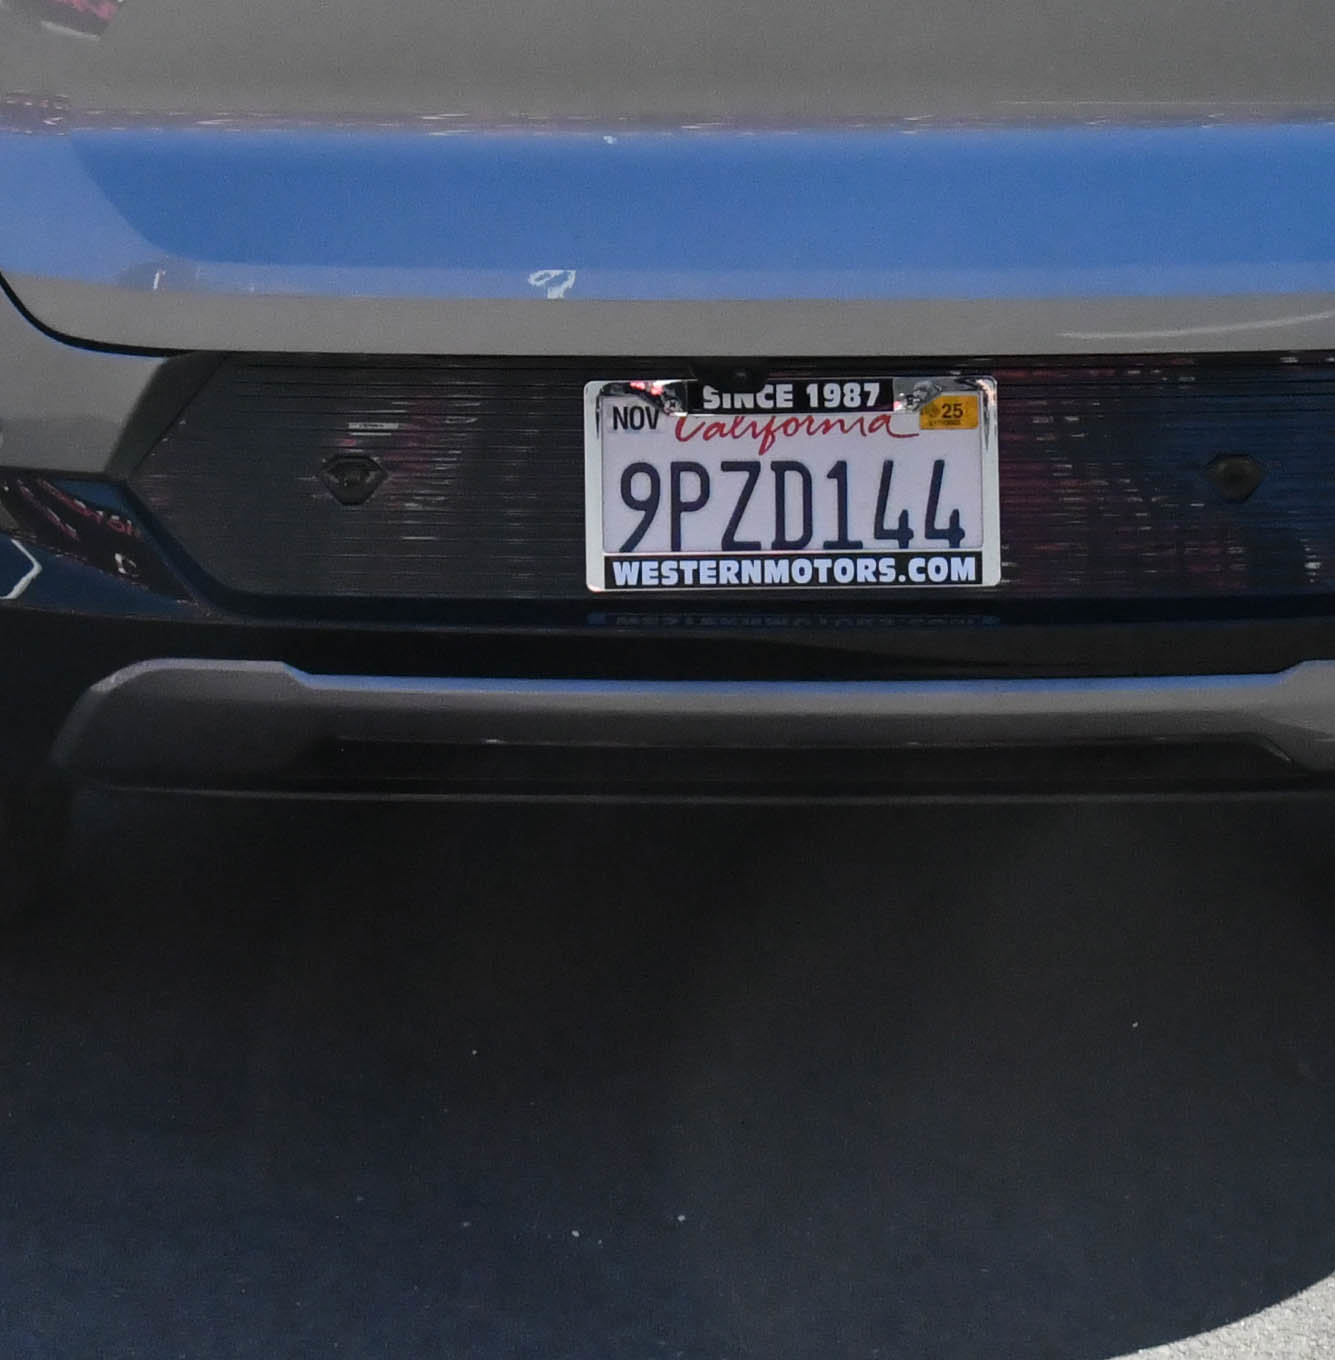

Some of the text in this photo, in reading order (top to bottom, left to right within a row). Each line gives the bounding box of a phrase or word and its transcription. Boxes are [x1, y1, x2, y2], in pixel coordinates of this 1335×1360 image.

[702, 382, 881, 410] SINCE 1987
[612, 405, 660, 431] NOV
[941, 403, 964, 419] 25
[674, 414, 920, 456] California
[618, 459, 966, 553] 9PZD144
[612, 556, 976, 586] WESTERNMOTORS.COM
